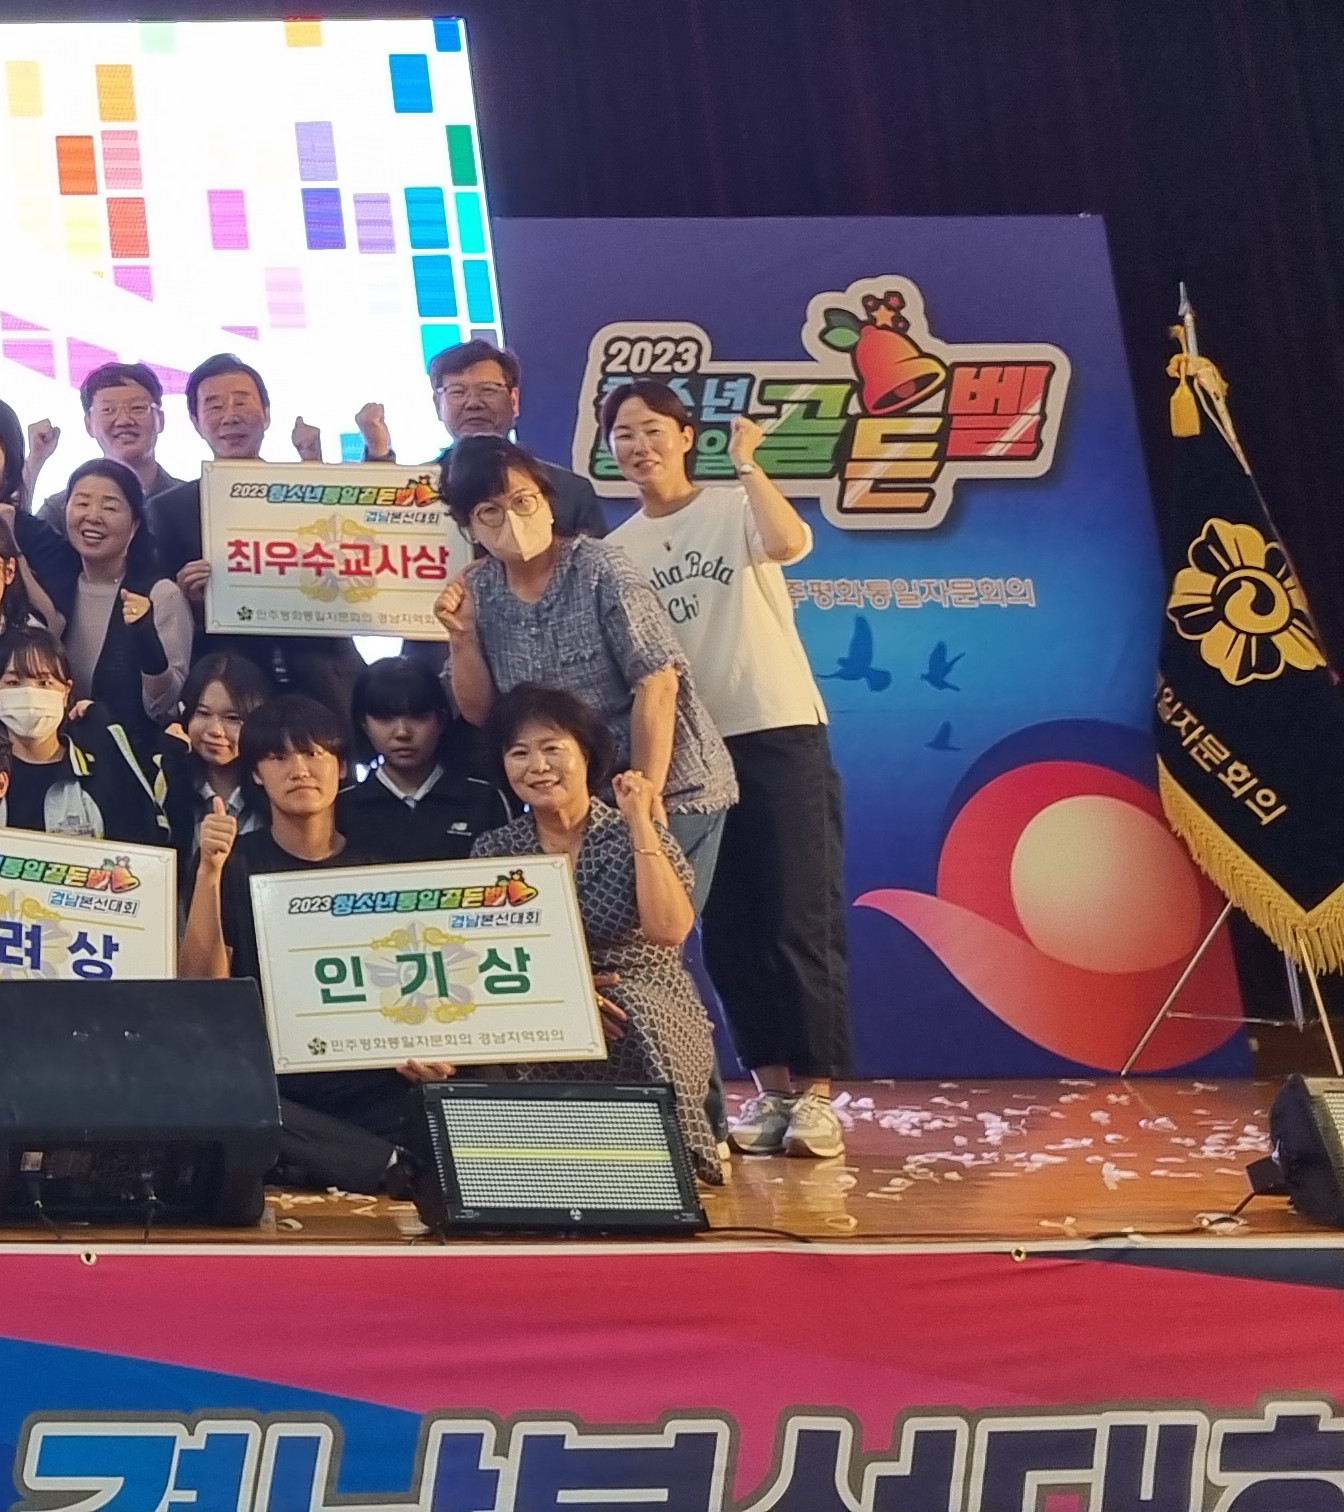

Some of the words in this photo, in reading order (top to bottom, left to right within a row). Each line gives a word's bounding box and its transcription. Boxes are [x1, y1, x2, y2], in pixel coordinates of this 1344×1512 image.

[602, 336, 703, 373] 2023
[227, 539, 450, 580] 최우수교사상
[685, 551, 734, 586] Beta
[668, 593, 699, 623] Chi
[48, 889, 141, 918] 경남본선대회
